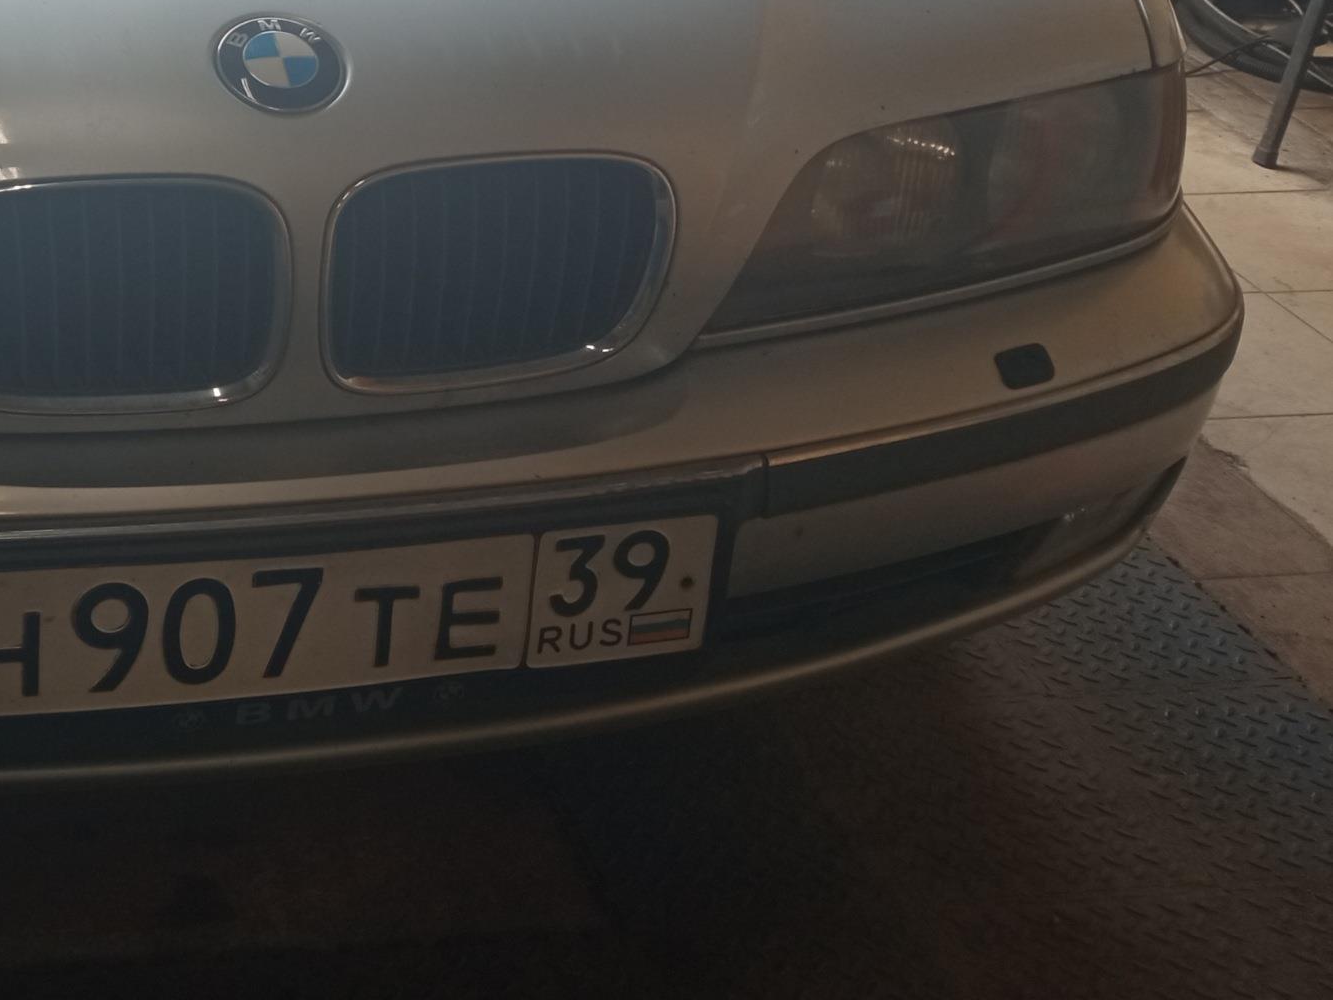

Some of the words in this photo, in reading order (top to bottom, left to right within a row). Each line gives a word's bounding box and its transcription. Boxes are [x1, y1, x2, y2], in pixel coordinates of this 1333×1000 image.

[226, 18, 321, 48] BMW
[549, 529, 671, 617] 39
[536, 616, 624, 655] RUS
[234, 686, 404, 725] BMW
